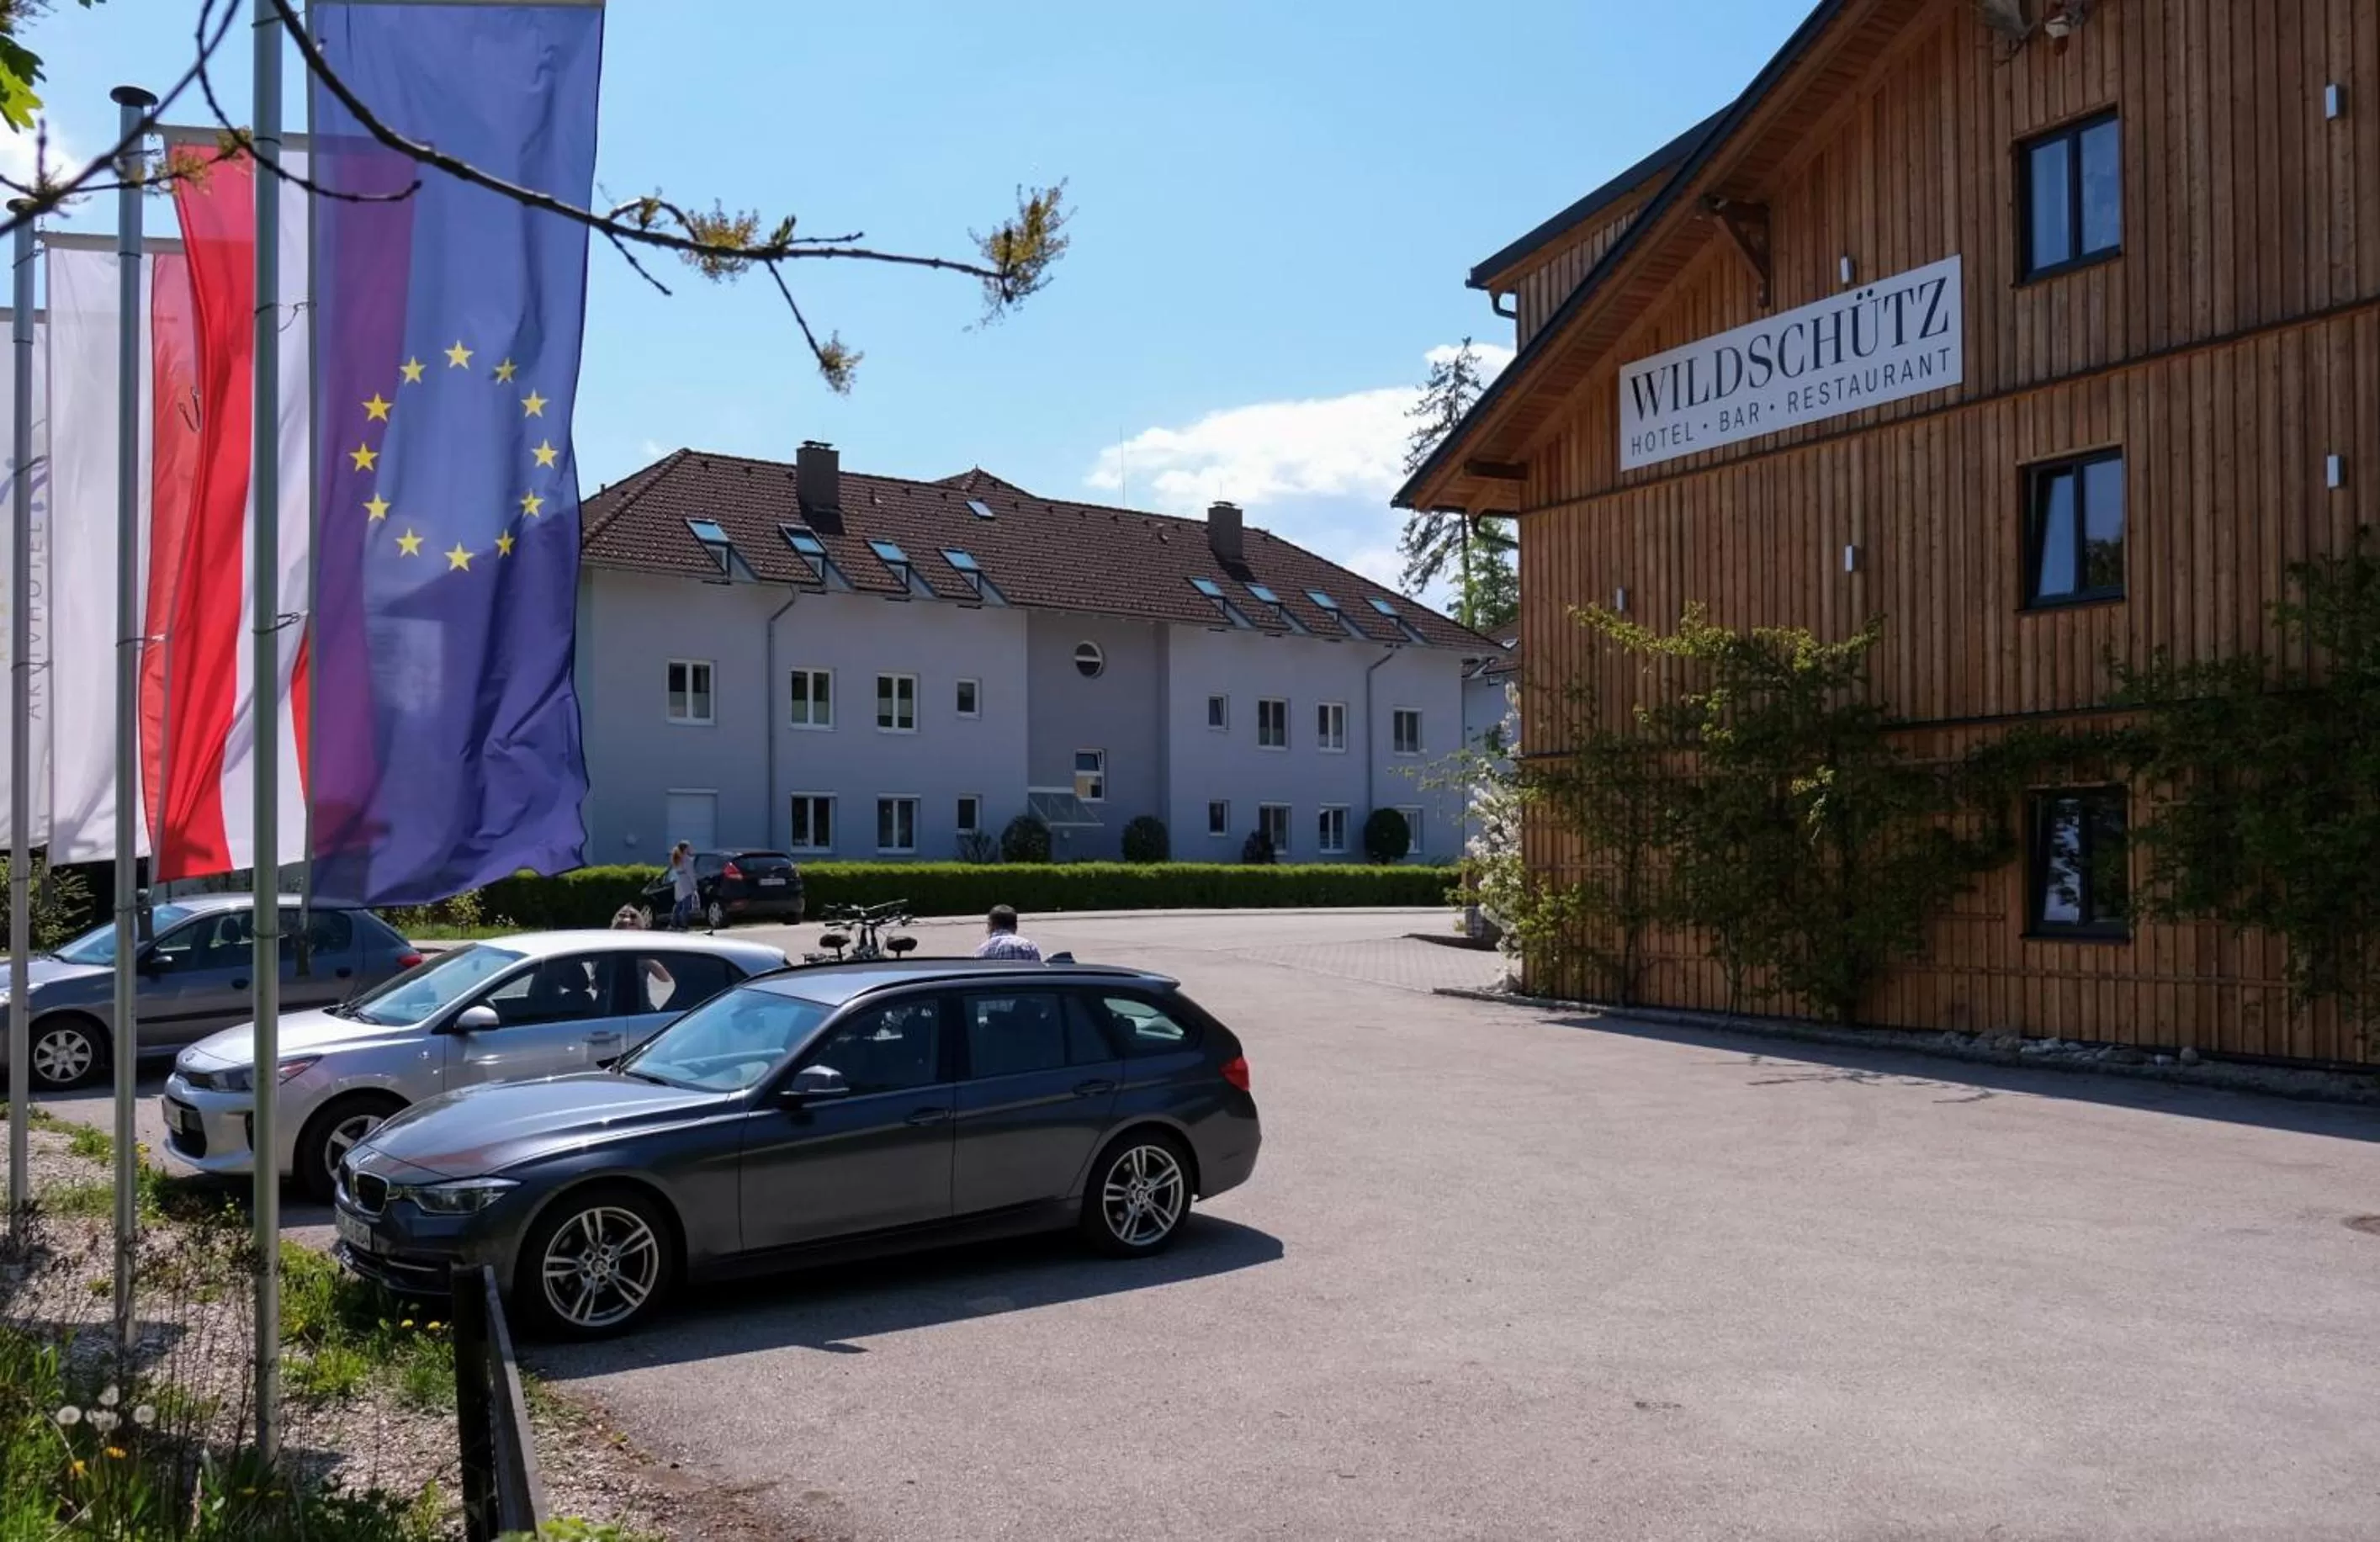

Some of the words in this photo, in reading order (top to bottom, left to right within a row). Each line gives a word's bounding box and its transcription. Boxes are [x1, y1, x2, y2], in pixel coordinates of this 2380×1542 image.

[1630, 276, 1949, 421] WILDSCHÜTZ
[1630, 421, 1694, 456] HOTEL
[1719, 402, 1760, 432] BAR
[1787, 347, 1951, 414] RESTAURANT
[28, 522, 42, 720] AKIVHOEL
